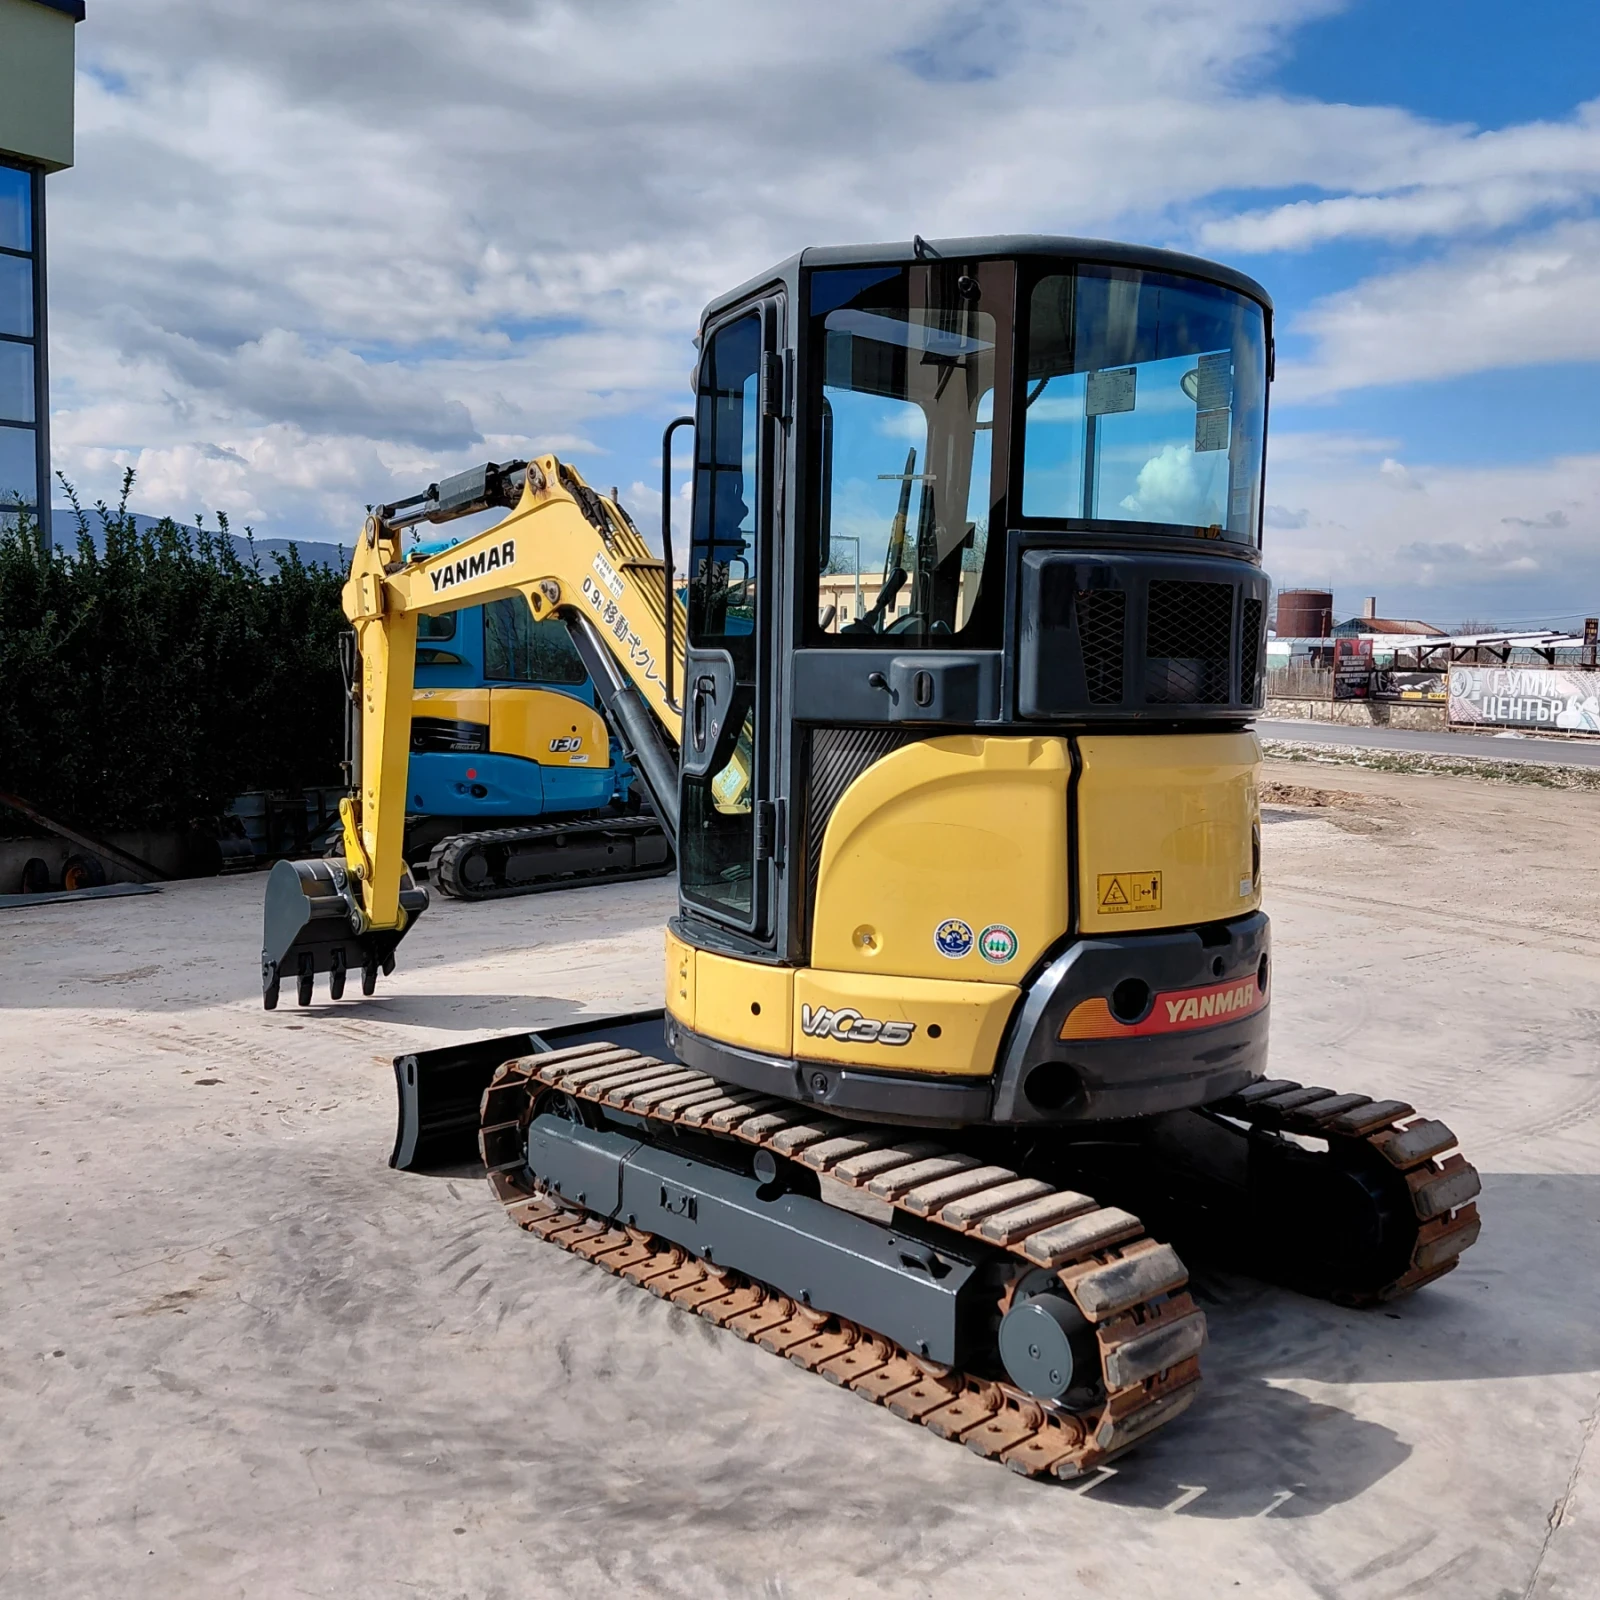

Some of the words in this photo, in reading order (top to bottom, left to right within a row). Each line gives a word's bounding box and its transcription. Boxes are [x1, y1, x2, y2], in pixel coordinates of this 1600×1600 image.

[430, 540, 515, 592] YANMAR
[583, 577, 602, 610] 0.9t
[1493, 670, 1557, 697] ГУМИ
[1483, 696, 1563, 721] ЦЕНТЪР
[549, 734, 582, 752] U-30
[1165, 983, 1254, 1023] YANMAR
